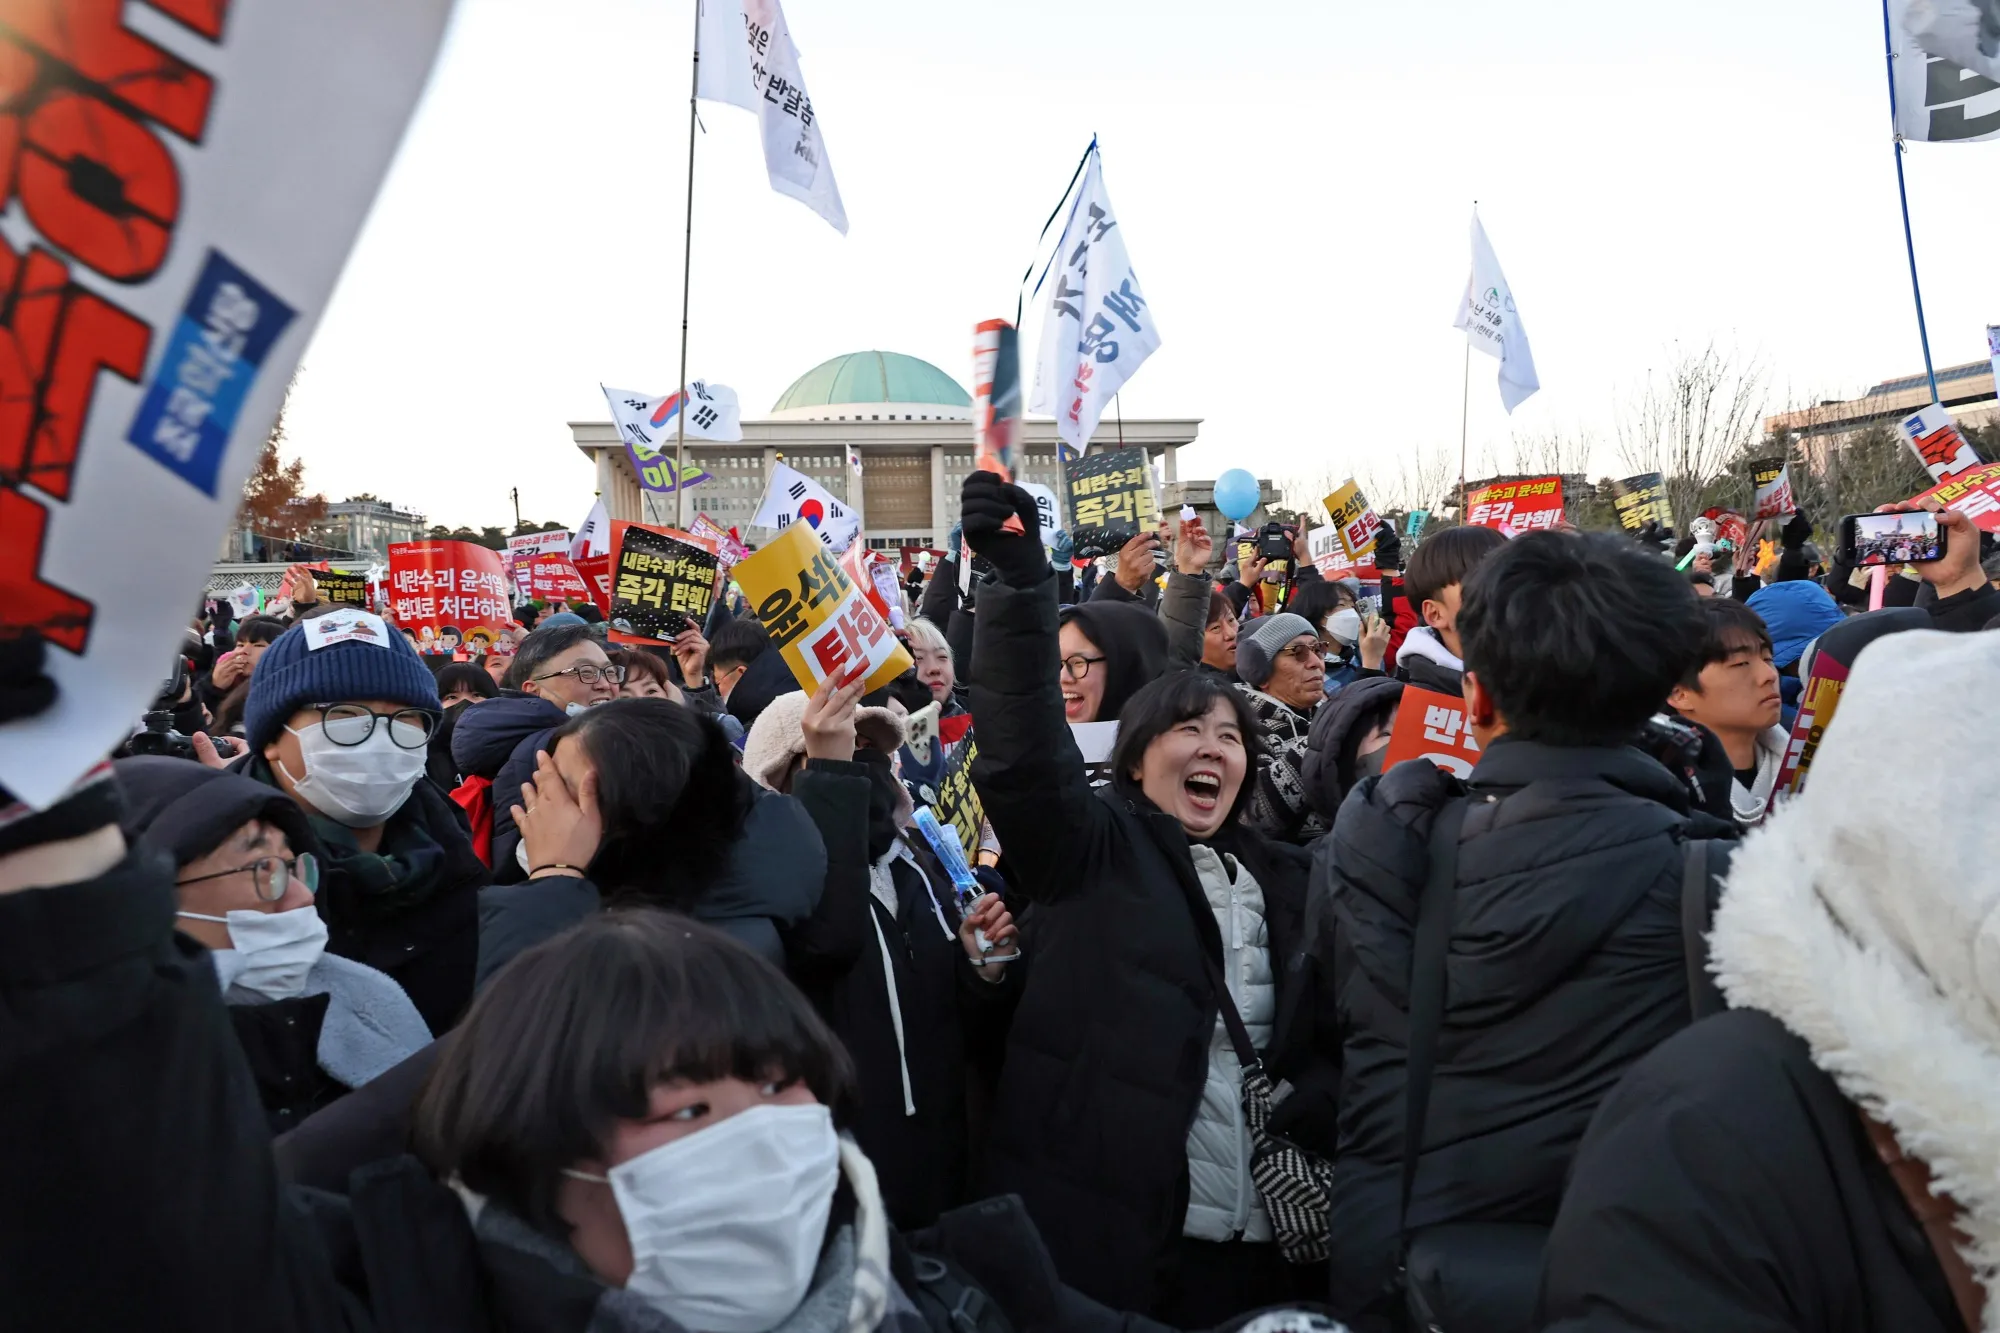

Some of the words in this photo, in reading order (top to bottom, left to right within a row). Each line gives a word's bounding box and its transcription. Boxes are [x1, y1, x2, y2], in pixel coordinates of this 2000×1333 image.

[1072, 466, 1143, 497] 내란수괴
[1471, 486, 1517, 506] 내란수괴
[1518, 481, 1557, 498] 윤석열
[1931, 465, 2000, 505] 란수괴
[1076, 490, 1135, 528] 즉각
[1331, 491, 1369, 531] 윤석열
[1469, 501, 1515, 525] 즉각
[394, 567, 455, 593] 내란수괴
[459, 569, 505, 598] 윤석열
[622, 551, 676, 577] 내란수괴
[686, 563, 715, 586] 윤석열
[397, 596, 437, 621] 법대로
[439, 595, 512, 626] 처단하라
[617, 573, 666, 609] 즉각
[670, 582, 712, 616] 탄핵!
[757, 547, 851, 650] 윤석열
